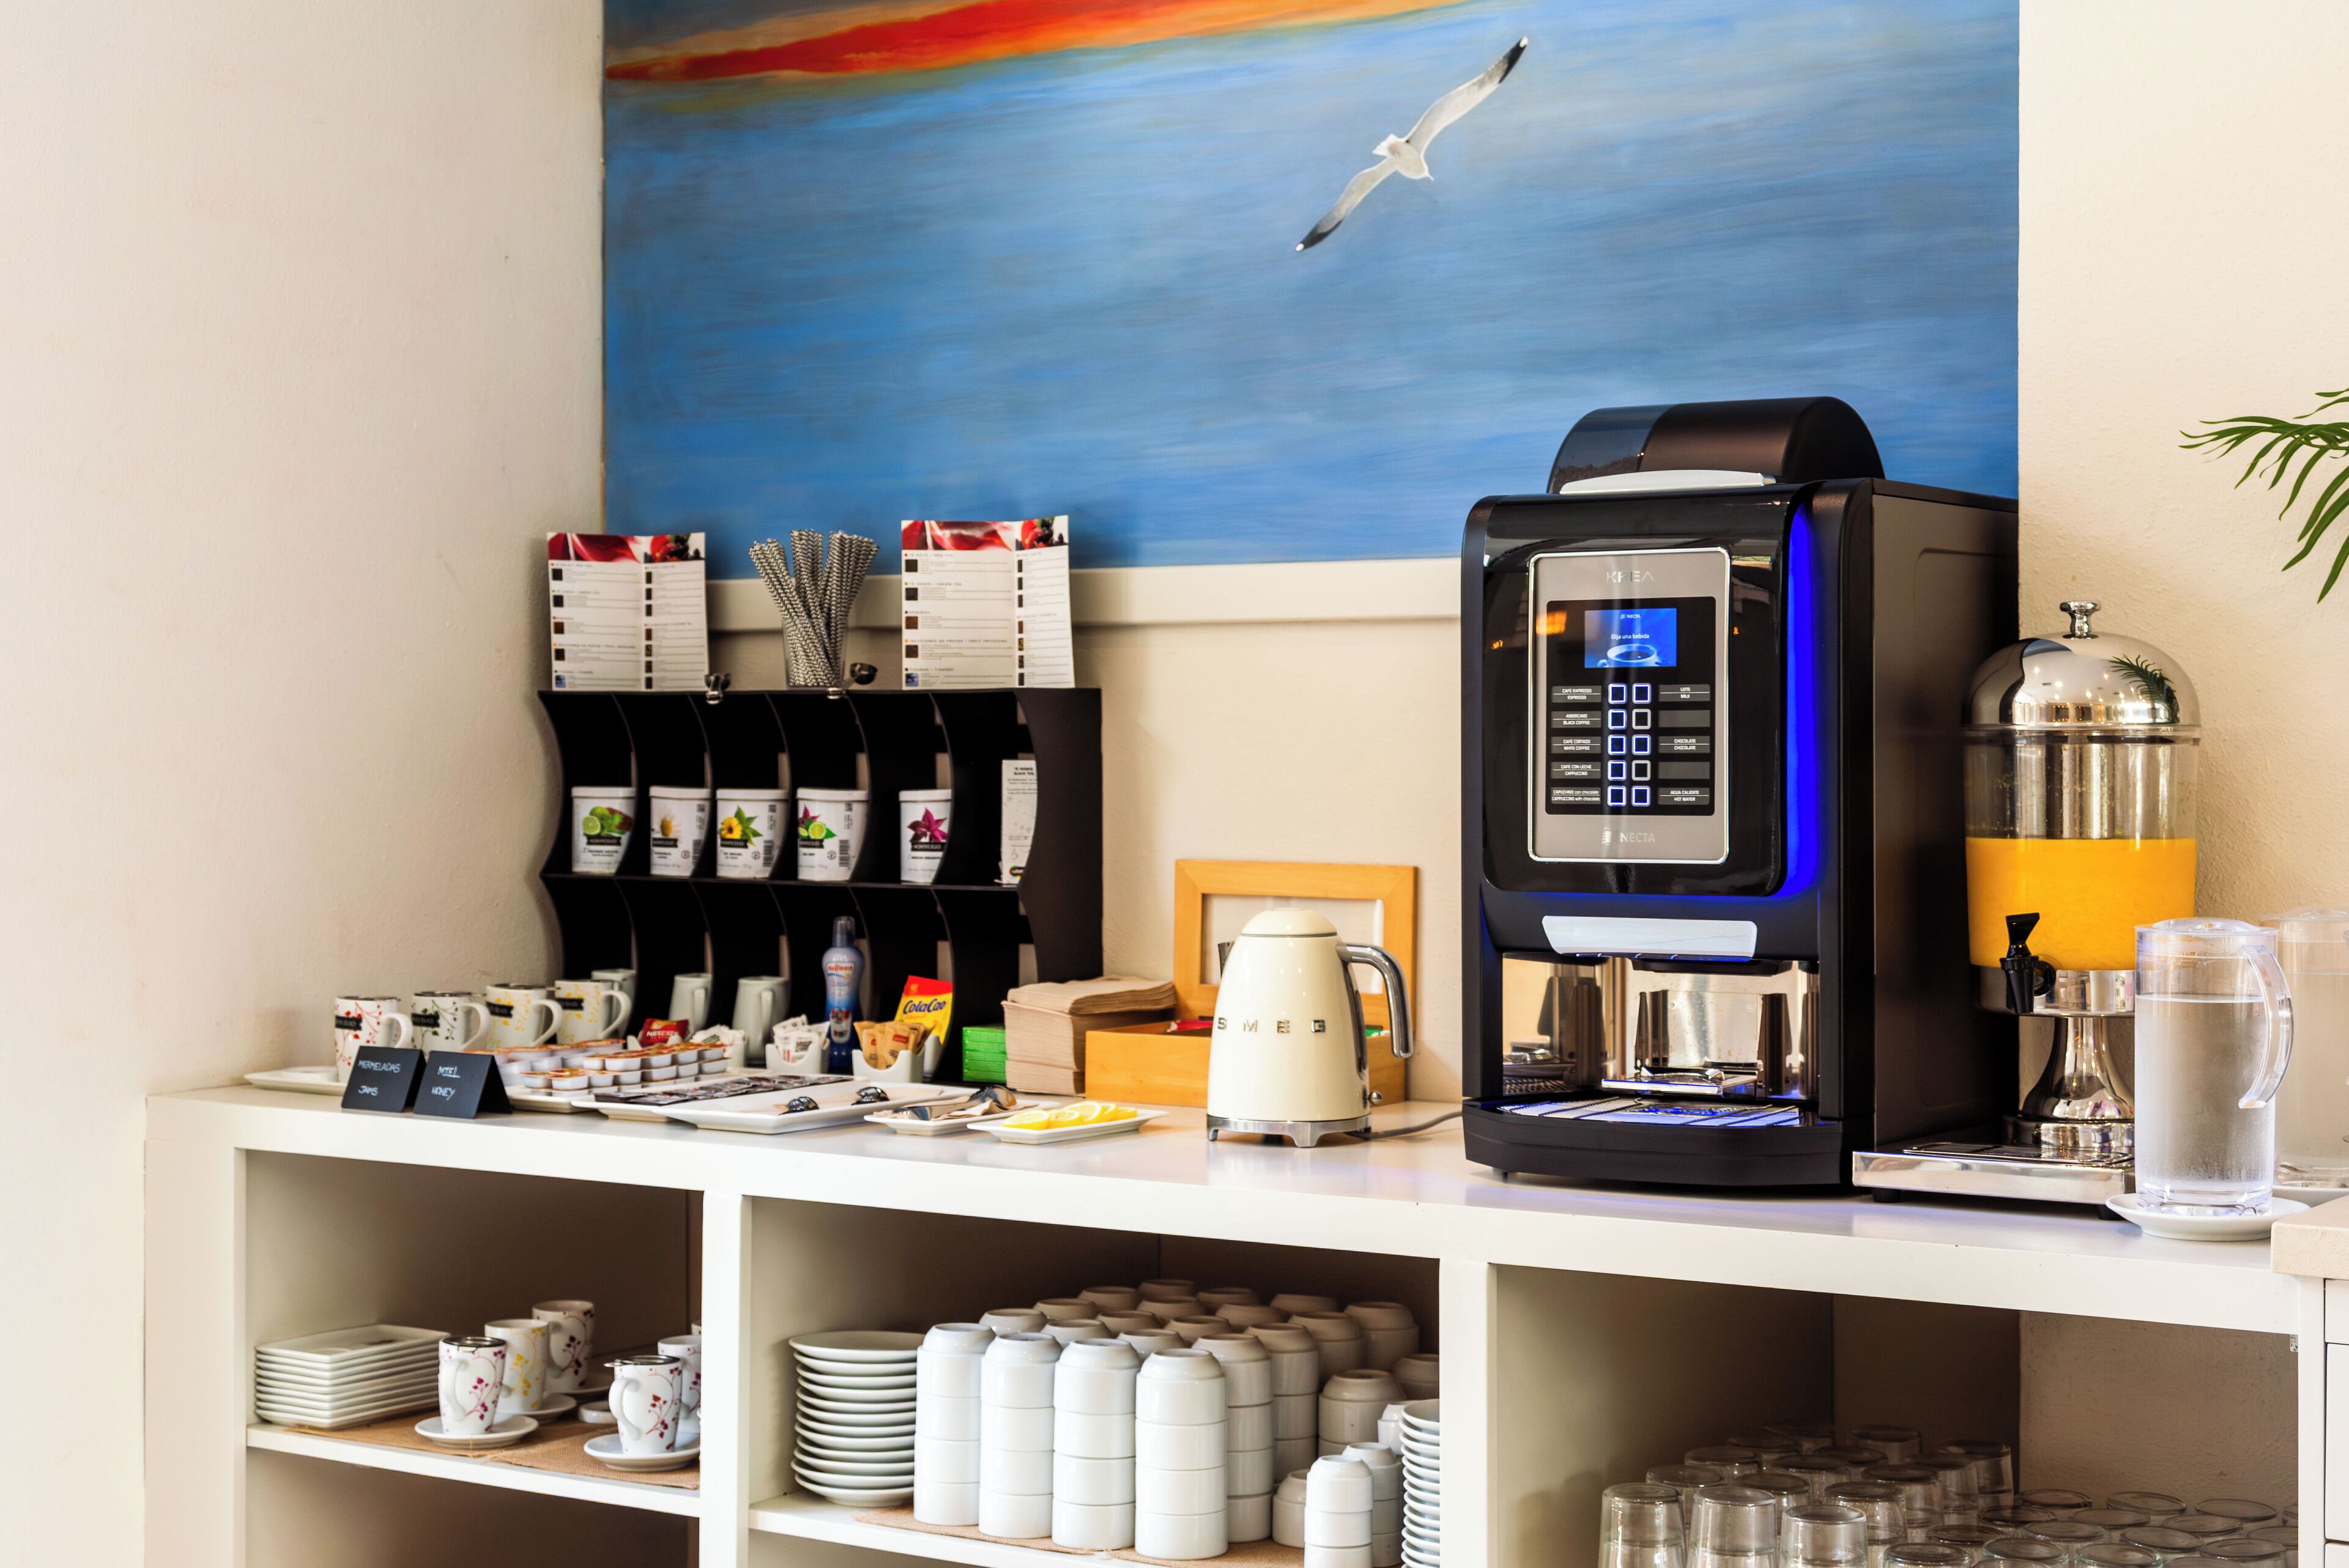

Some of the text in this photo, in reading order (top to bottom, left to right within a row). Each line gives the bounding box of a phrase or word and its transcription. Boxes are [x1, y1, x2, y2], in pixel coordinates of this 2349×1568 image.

[1606, 571, 1654, 582] KREA
[1619, 832, 1655, 843] NECTA
[903, 998, 946, 1014] ColaCao
[1217, 1017, 1326, 1033] SMEG
[358, 1059, 401, 1074] MERMELADAS
[358, 1085, 379, 1097] JAMS
[431, 1086, 456, 1101] HONEY
